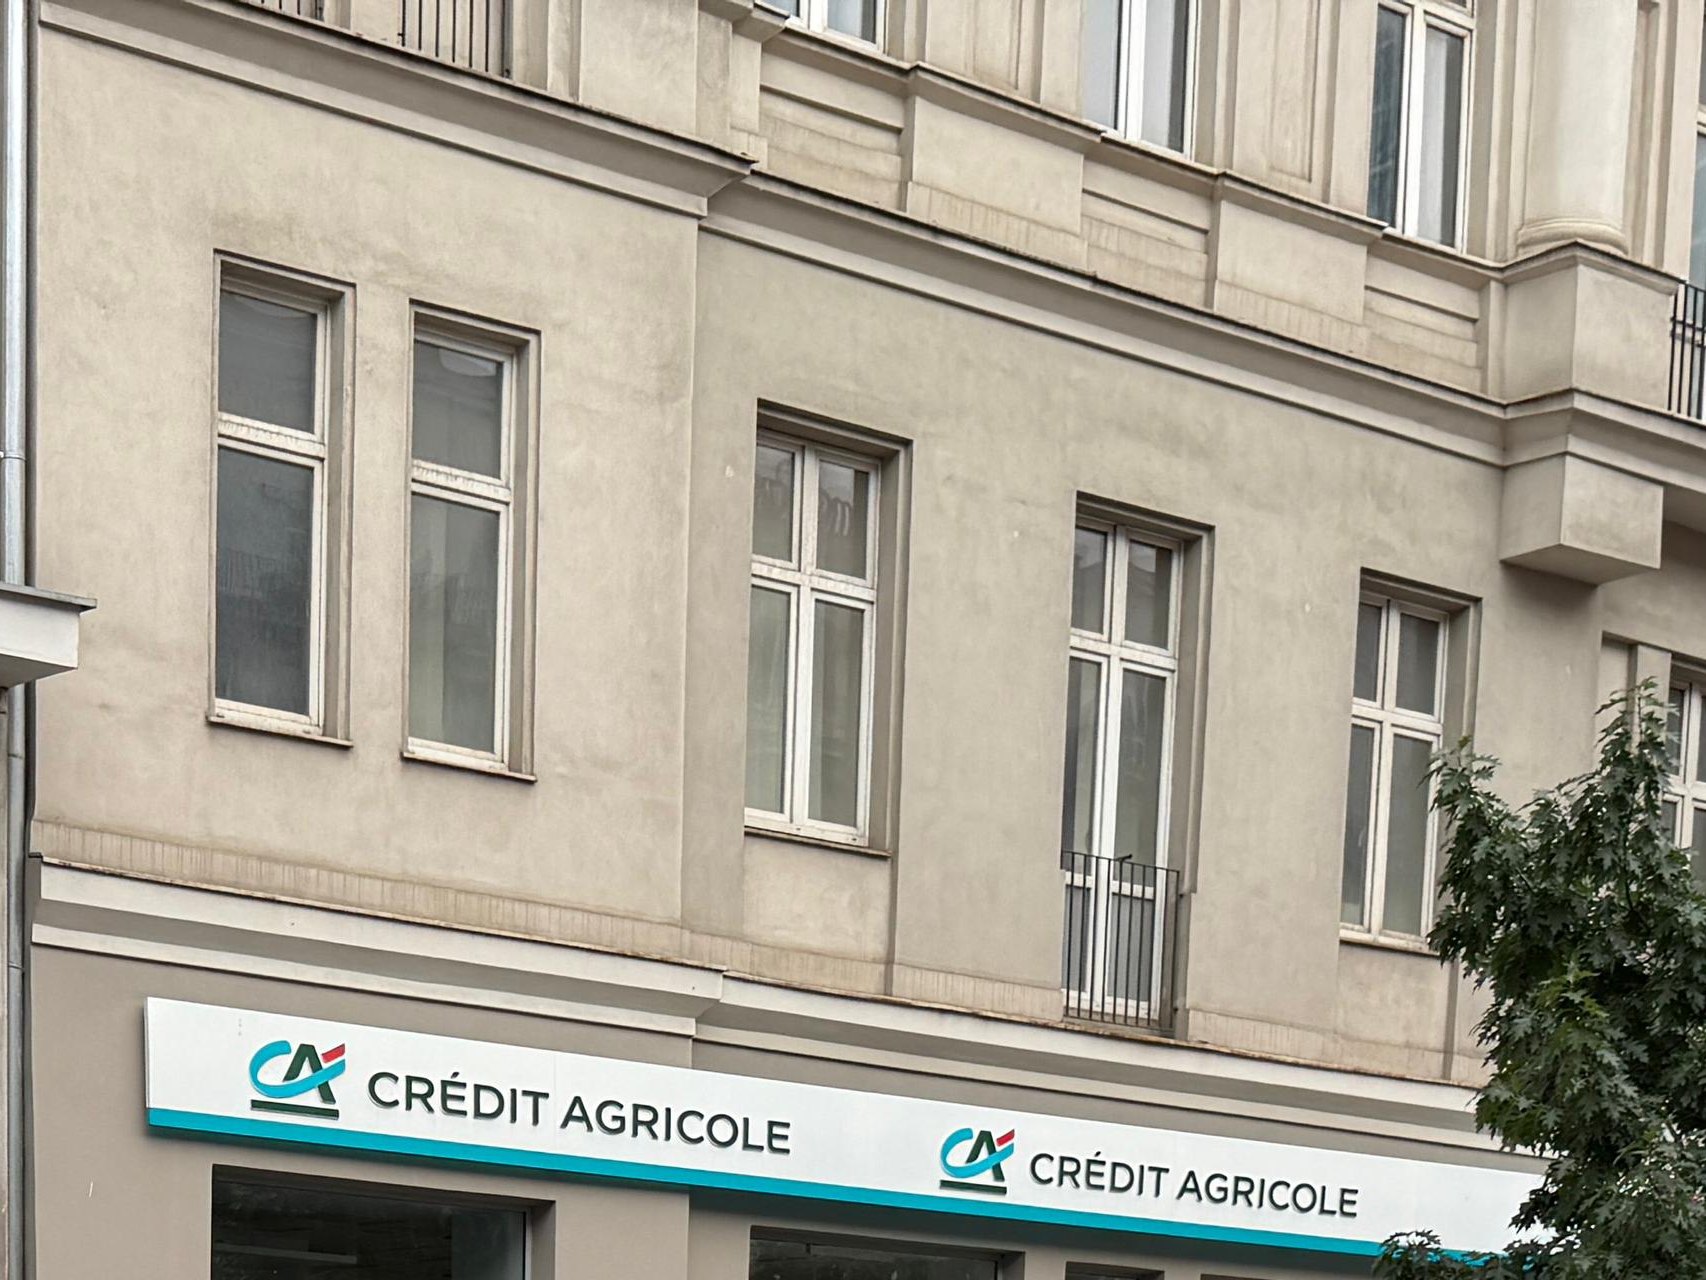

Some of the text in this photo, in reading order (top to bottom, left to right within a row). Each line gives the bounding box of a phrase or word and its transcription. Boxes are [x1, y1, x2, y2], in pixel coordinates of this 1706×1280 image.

[368, 1071, 549, 1126] CRÉDIT
[560, 1095, 791, 1154] AGRICOLE
[1030, 1151, 1170, 1198] CRÉDIT
[1177, 1169, 1359, 1218] AGRICOLE
